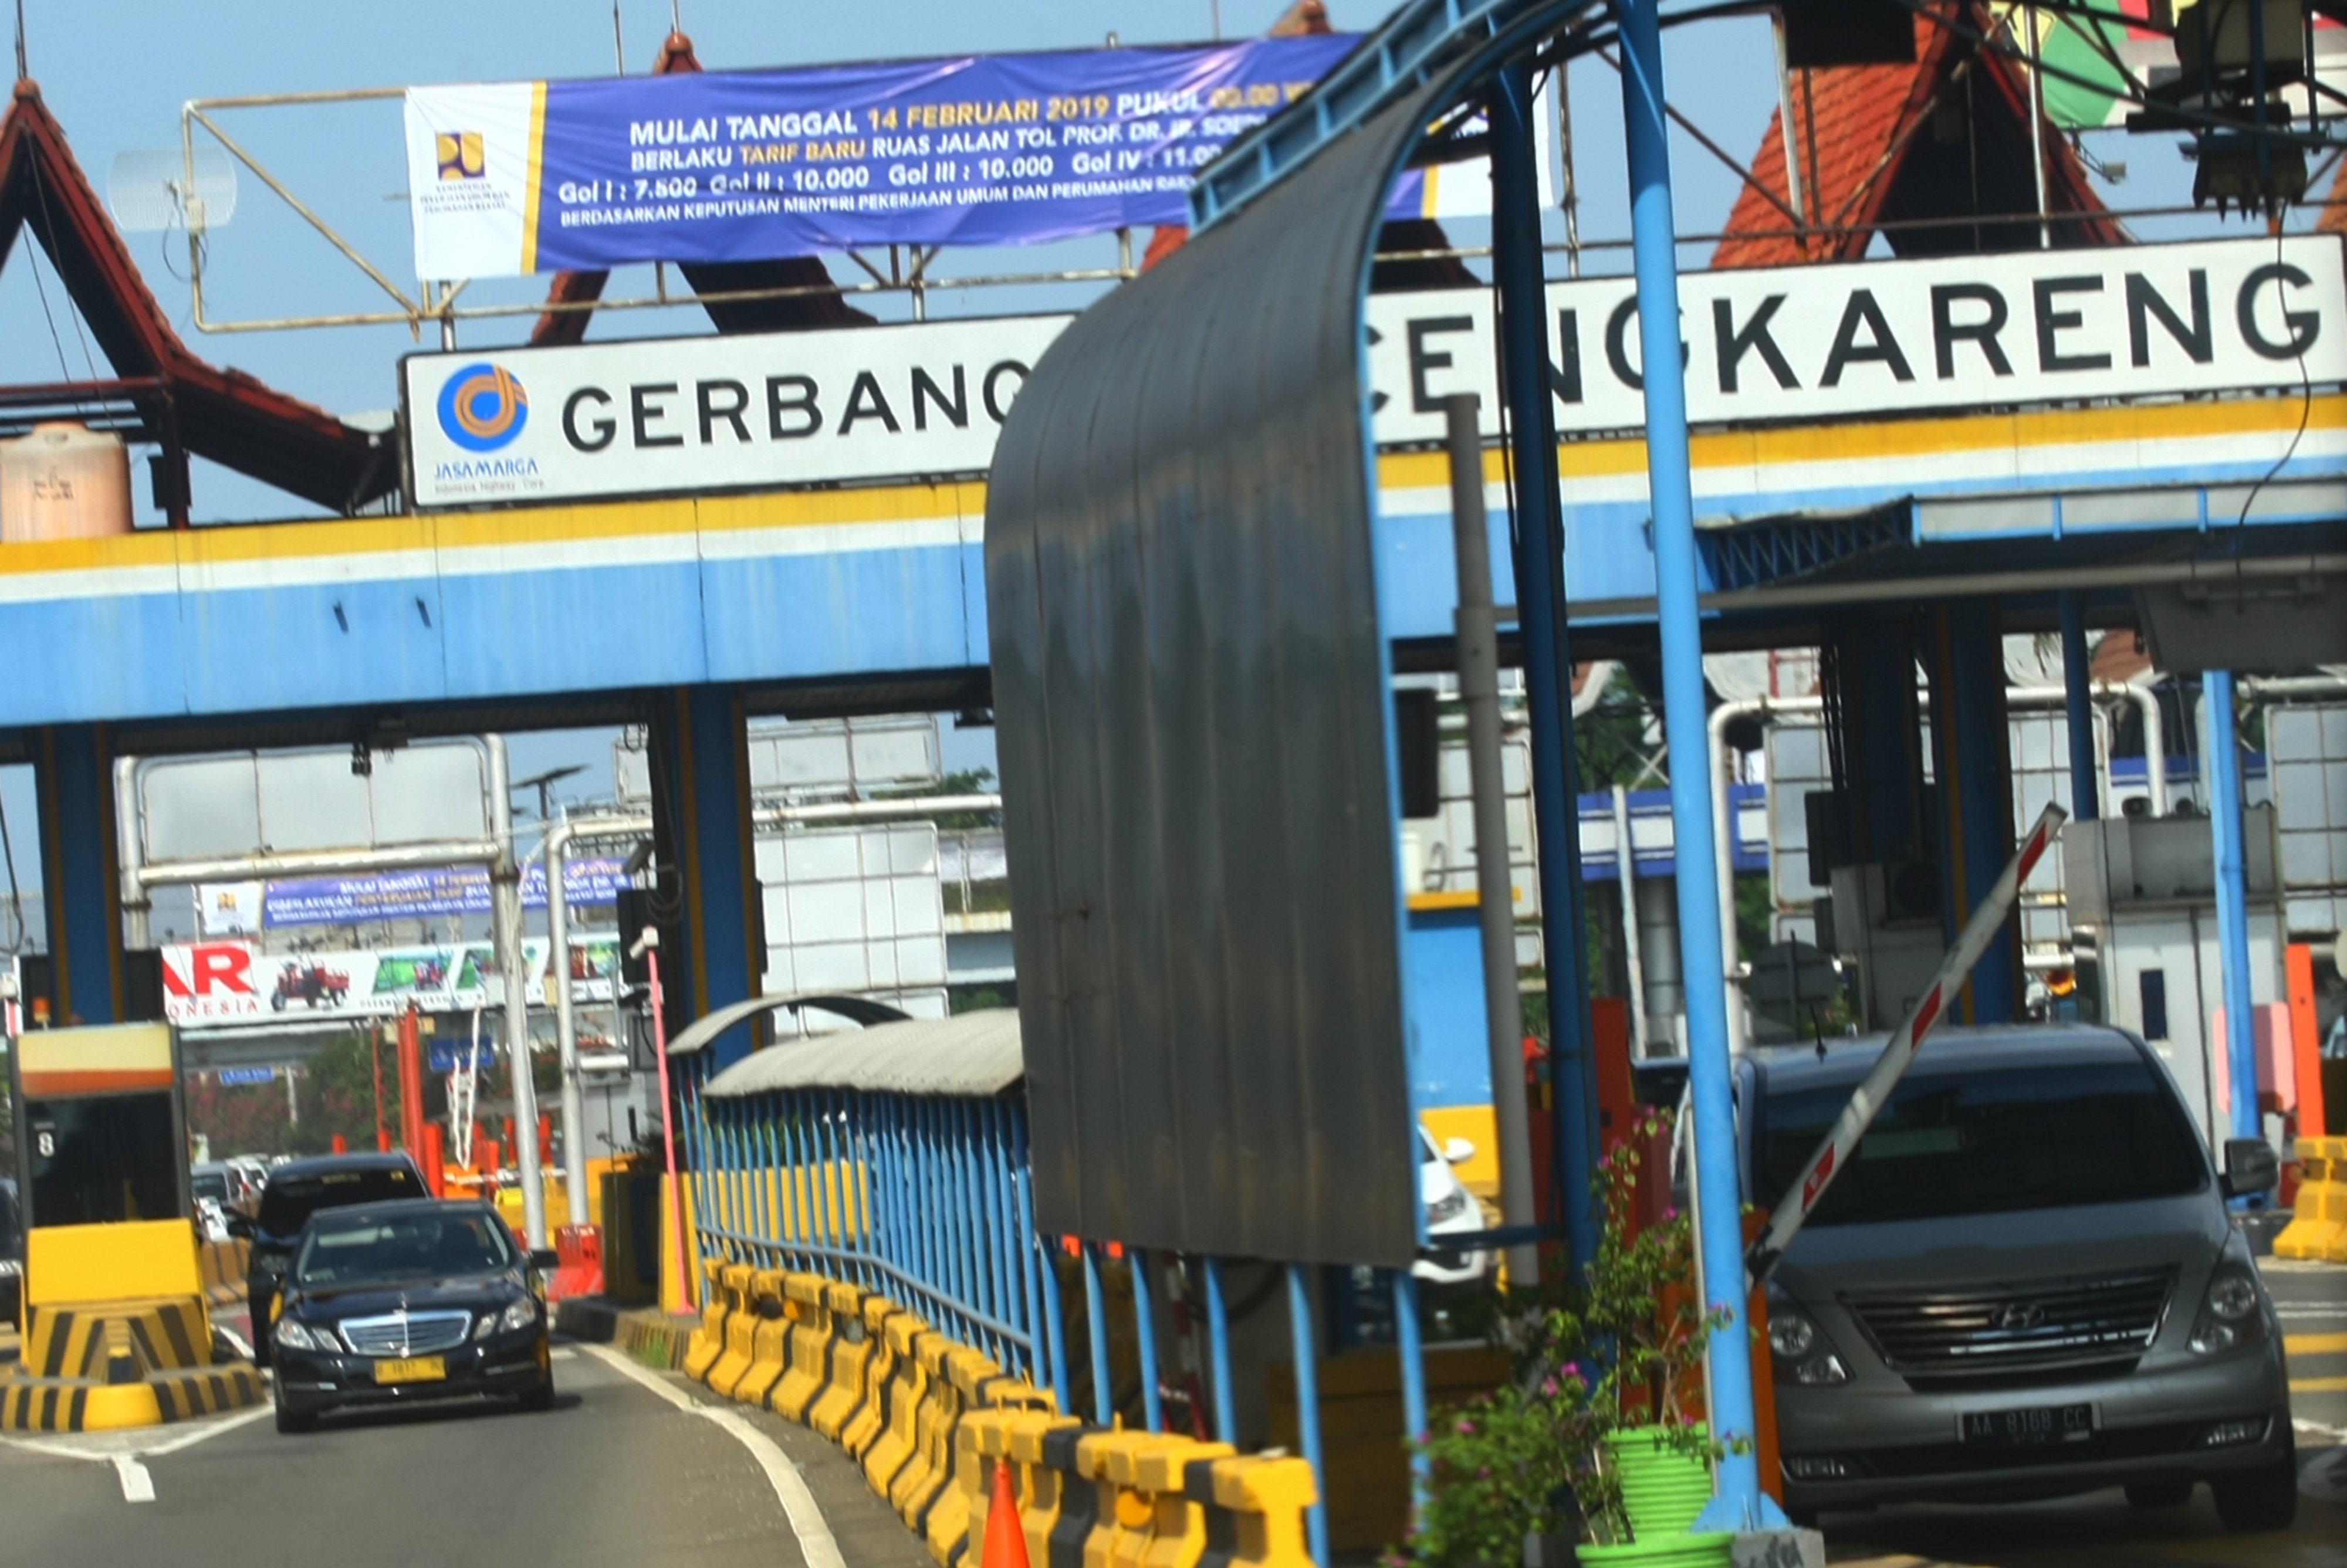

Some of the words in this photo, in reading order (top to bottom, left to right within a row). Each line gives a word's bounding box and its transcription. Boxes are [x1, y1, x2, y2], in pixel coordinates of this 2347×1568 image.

[630, 117, 718, 146] MULAI
[726, 110, 858, 141] TANGGAL
[868, 106, 898, 133] 14
[907, 99, 1038, 129] FEBRUARI
[1046, 94, 1110, 121] 2019
[631, 146, 732, 172] BERLAKU
[740, 143, 799, 166] TARIF
[805, 139, 865, 162] BARU
[872, 134, 930, 158] RUAS
[936, 130, 1009, 154] JALAN
[1016, 127, 1056, 148] TOL
[559, 180, 598, 204] Gol
[793, 166, 870, 191] 10.000
[888, 161, 929, 187] Gol
[979, 155, 1054, 180] 10.000
[1071, 150, 1111, 175] Gol
[1118, 150, 1141, 170] IV
[561, 205, 679, 228] BERDASARKAN
[684, 198, 779, 219] KEPUTUSAN
[784, 194, 854, 215] MENTERI
[859, 189, 952, 210] PEKERJAAN
[956, 186, 1008, 206] UMUM
[1013, 184, 1048, 201] DAN
[1052, 178, 1152, 198] PERUMAHAN
[38, 1132, 55, 1157] 8
[1972, 1414, 1993, 1435] AA
